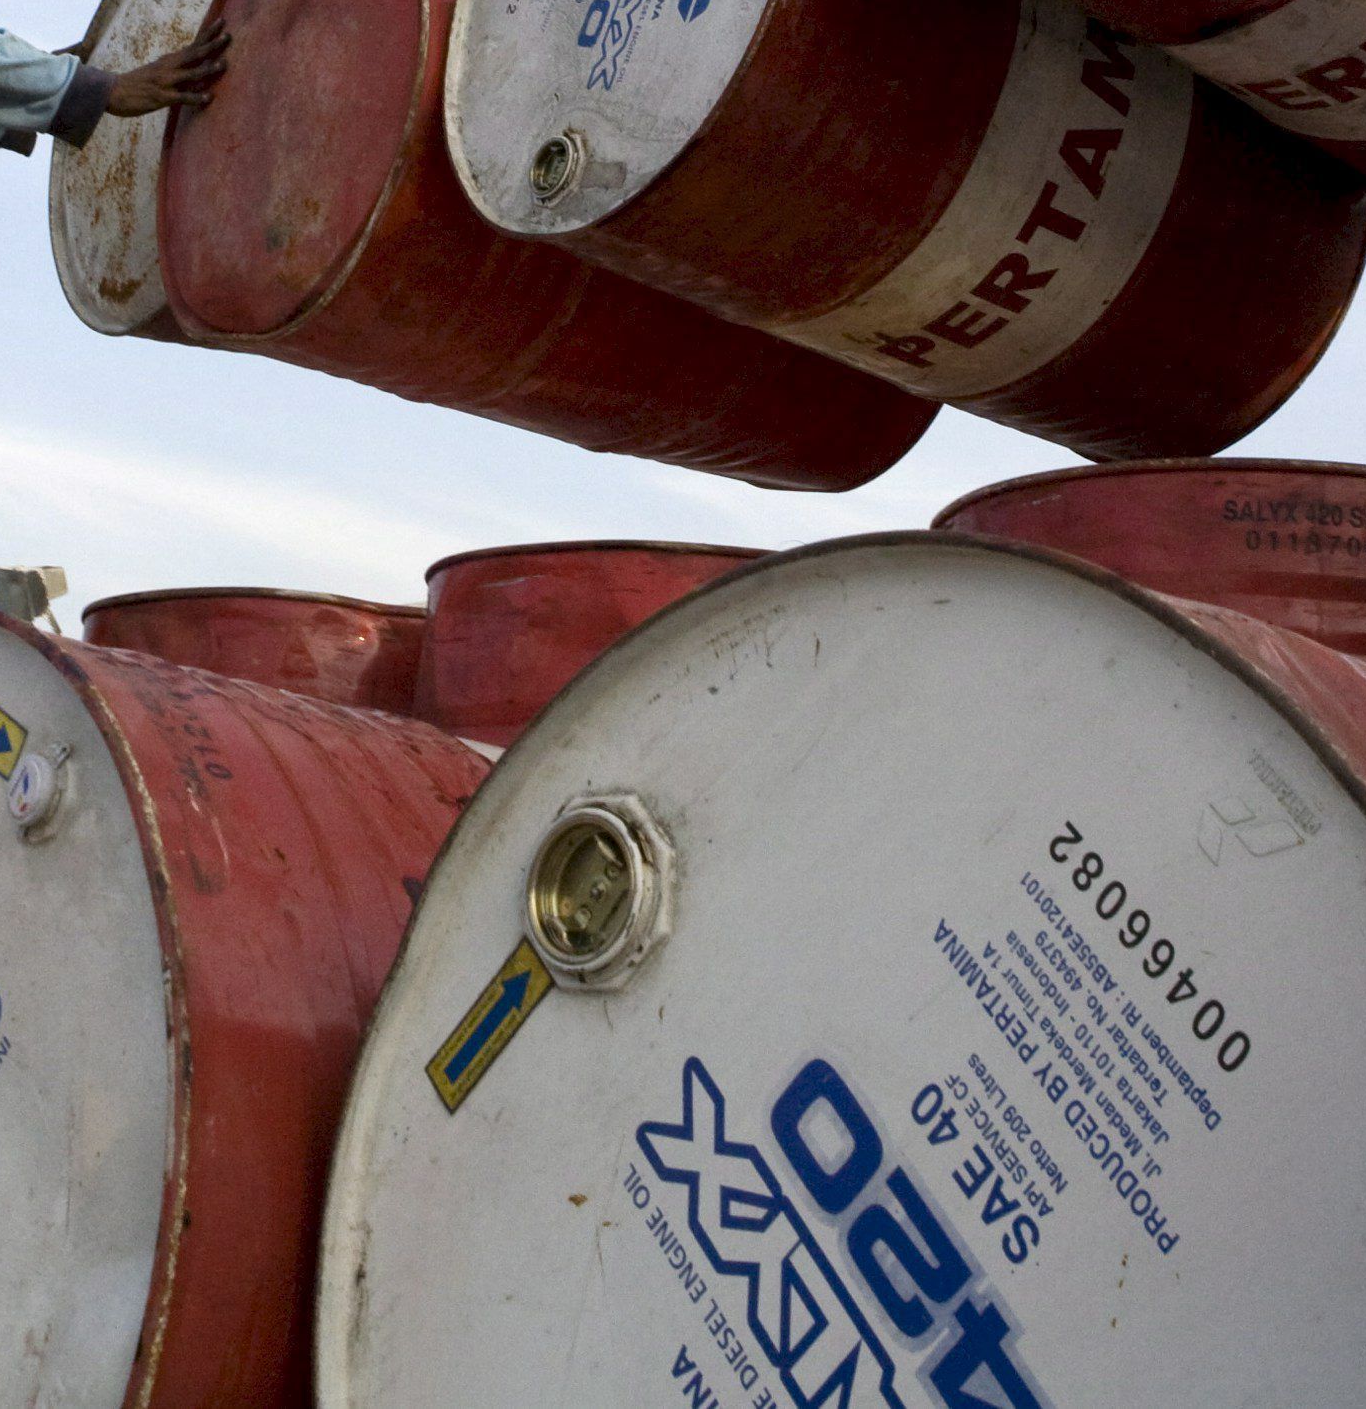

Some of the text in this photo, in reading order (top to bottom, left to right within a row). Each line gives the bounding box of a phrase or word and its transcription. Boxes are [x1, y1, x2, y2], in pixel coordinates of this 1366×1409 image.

[1223, 499, 1299, 524] SALYX
[983, 941, 1001, 968] 1A
[1006, 931, 1070, 1017] Indonesia
[1021, 872, 1118, 993] AB55E4120101
[1050, 821, 1251, 1073] 00466082
[1001, 969, 1040, 1023] Timur
[1035, 931, 1167, 1108] Terdaftar No. 494379
[1121, 1001, 1142, 1027] RI
[934, 919, 1180, 1255] PRODUCED BY PERTAMINA
[1040, 1017, 1096, 1094] Merdeka
[1074, 1024, 1115, 1078] 10110
[1141, 1024, 1222, 1131] Deptamben
[945, 1075, 1054, 1217] API SERVICE CF
[968, 1053, 1068, 1195] Netto 209 Litres
[1096, 1091, 1143, 1157] Medan
[1117, 1076, 1169, 1144] Jakarta
[624, 1163, 650, 1209] OIL
[911, 1084, 1040, 1264] SAE 40
[646, 1207, 707, 1304] ENGINE
[772, 1060, 1041, 1409] 420
[704, 1299, 759, 1391] DIESEL
